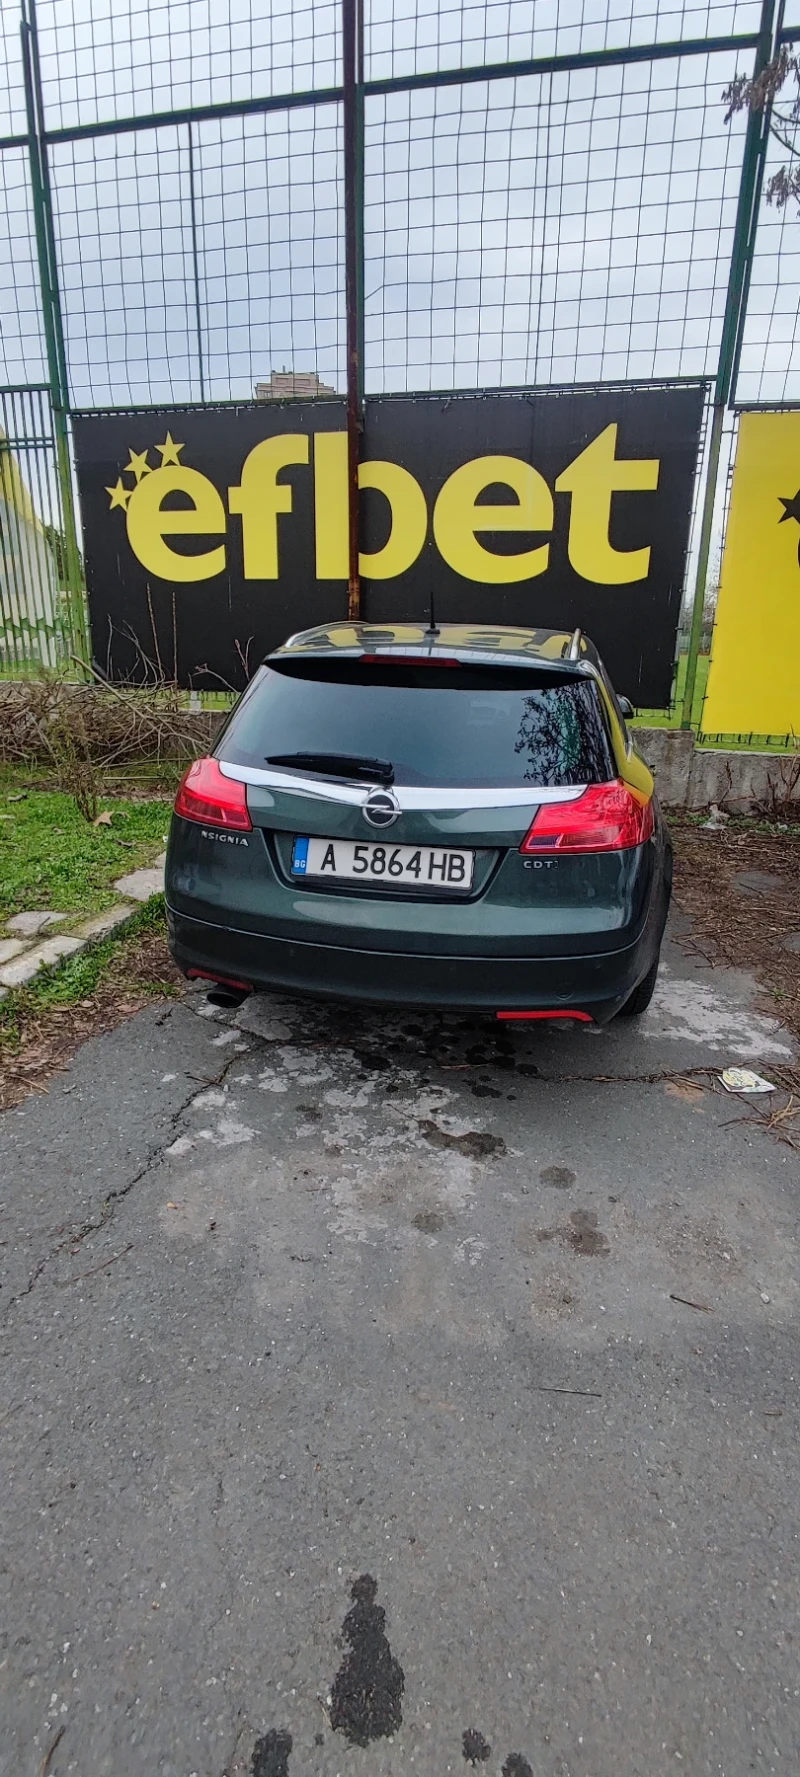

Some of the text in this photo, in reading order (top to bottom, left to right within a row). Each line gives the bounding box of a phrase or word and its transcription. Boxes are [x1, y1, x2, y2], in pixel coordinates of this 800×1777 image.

[126, 423, 660, 585] efbet
[294, 859, 306, 869] BG
[320, 843, 337, 872] A
